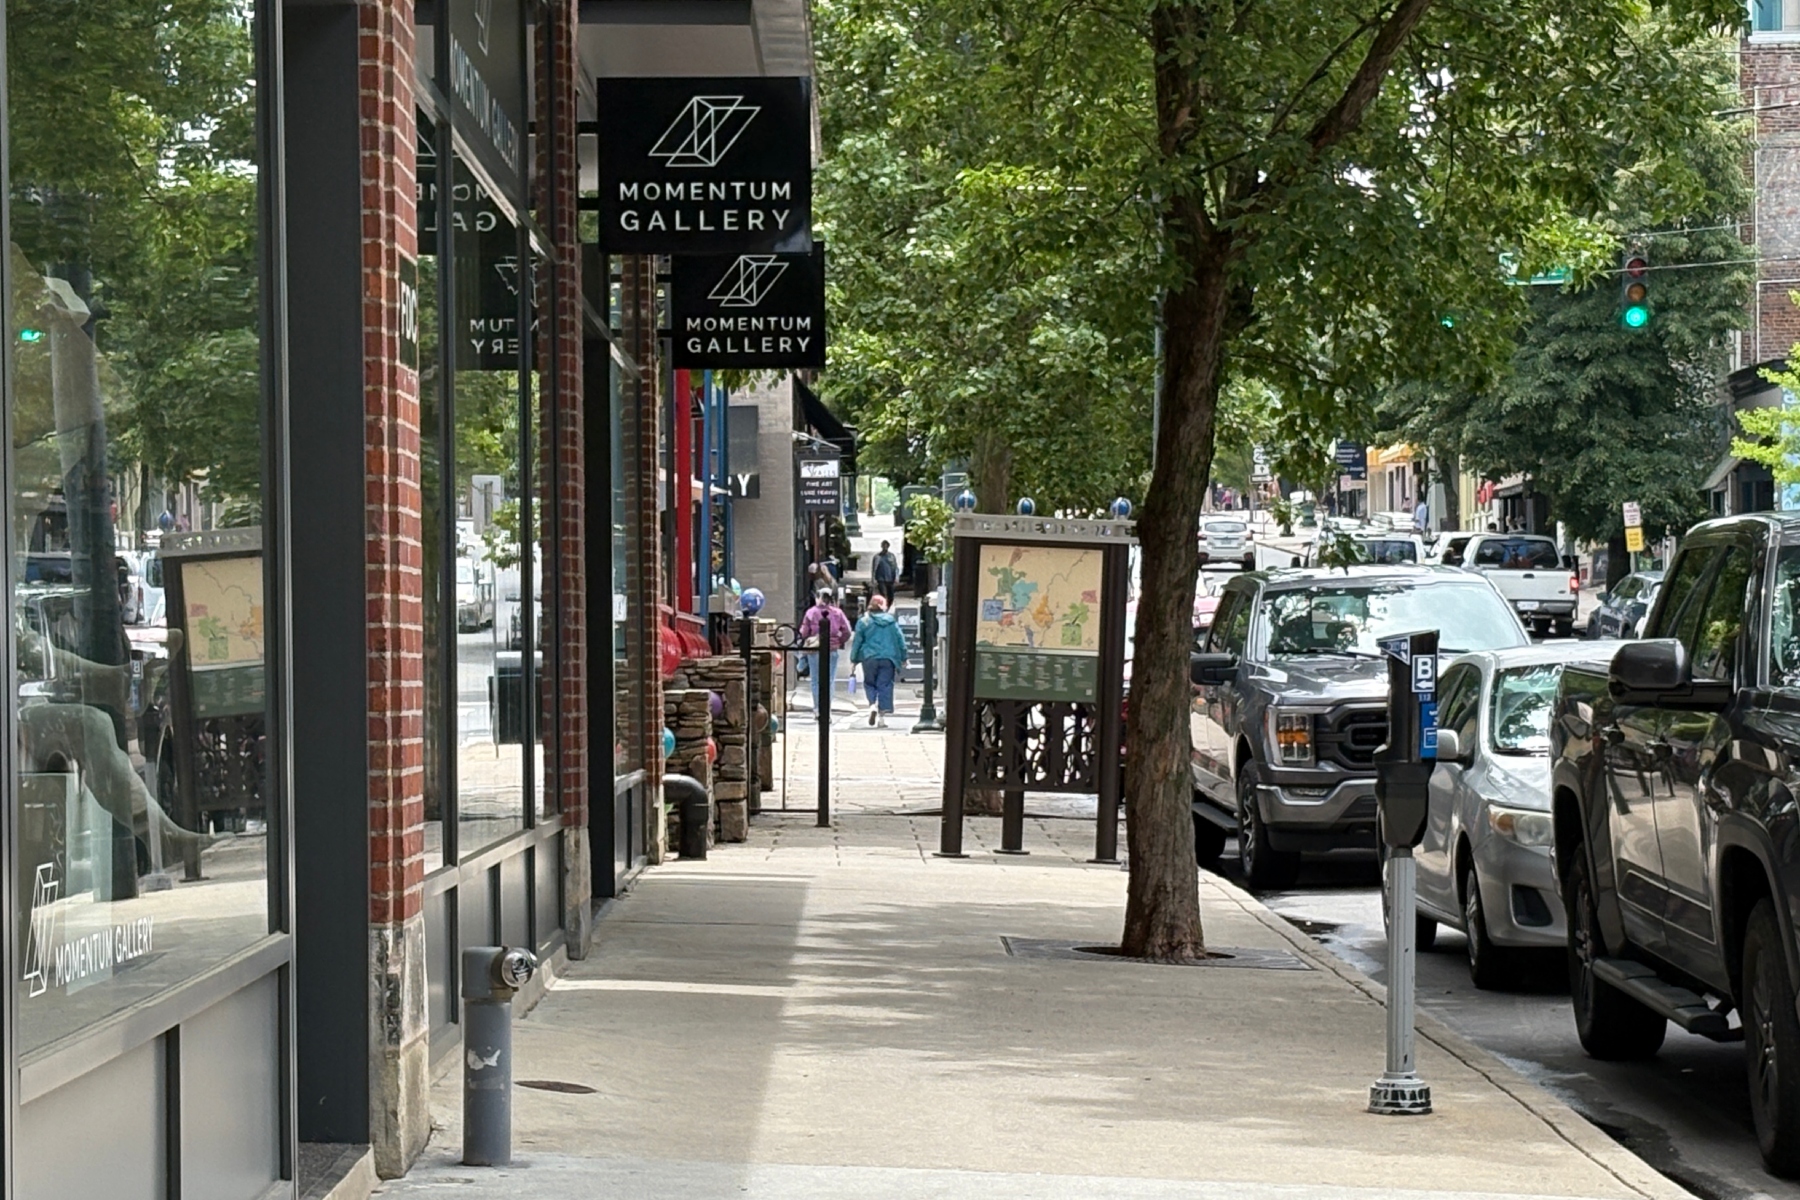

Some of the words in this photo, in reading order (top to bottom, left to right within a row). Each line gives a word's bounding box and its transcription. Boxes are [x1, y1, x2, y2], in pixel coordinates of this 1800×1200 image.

[619, 181, 792, 201] MOMENTUM
[619, 209, 791, 232] GALLERY
[686, 317, 812, 331] MOMENTUM
[686, 337, 811, 354] GALLERY
[1417, 657, 1432, 680] B
[55, 928, 113, 988] MOMENTUM
[115, 915, 154, 964] GALLERY
